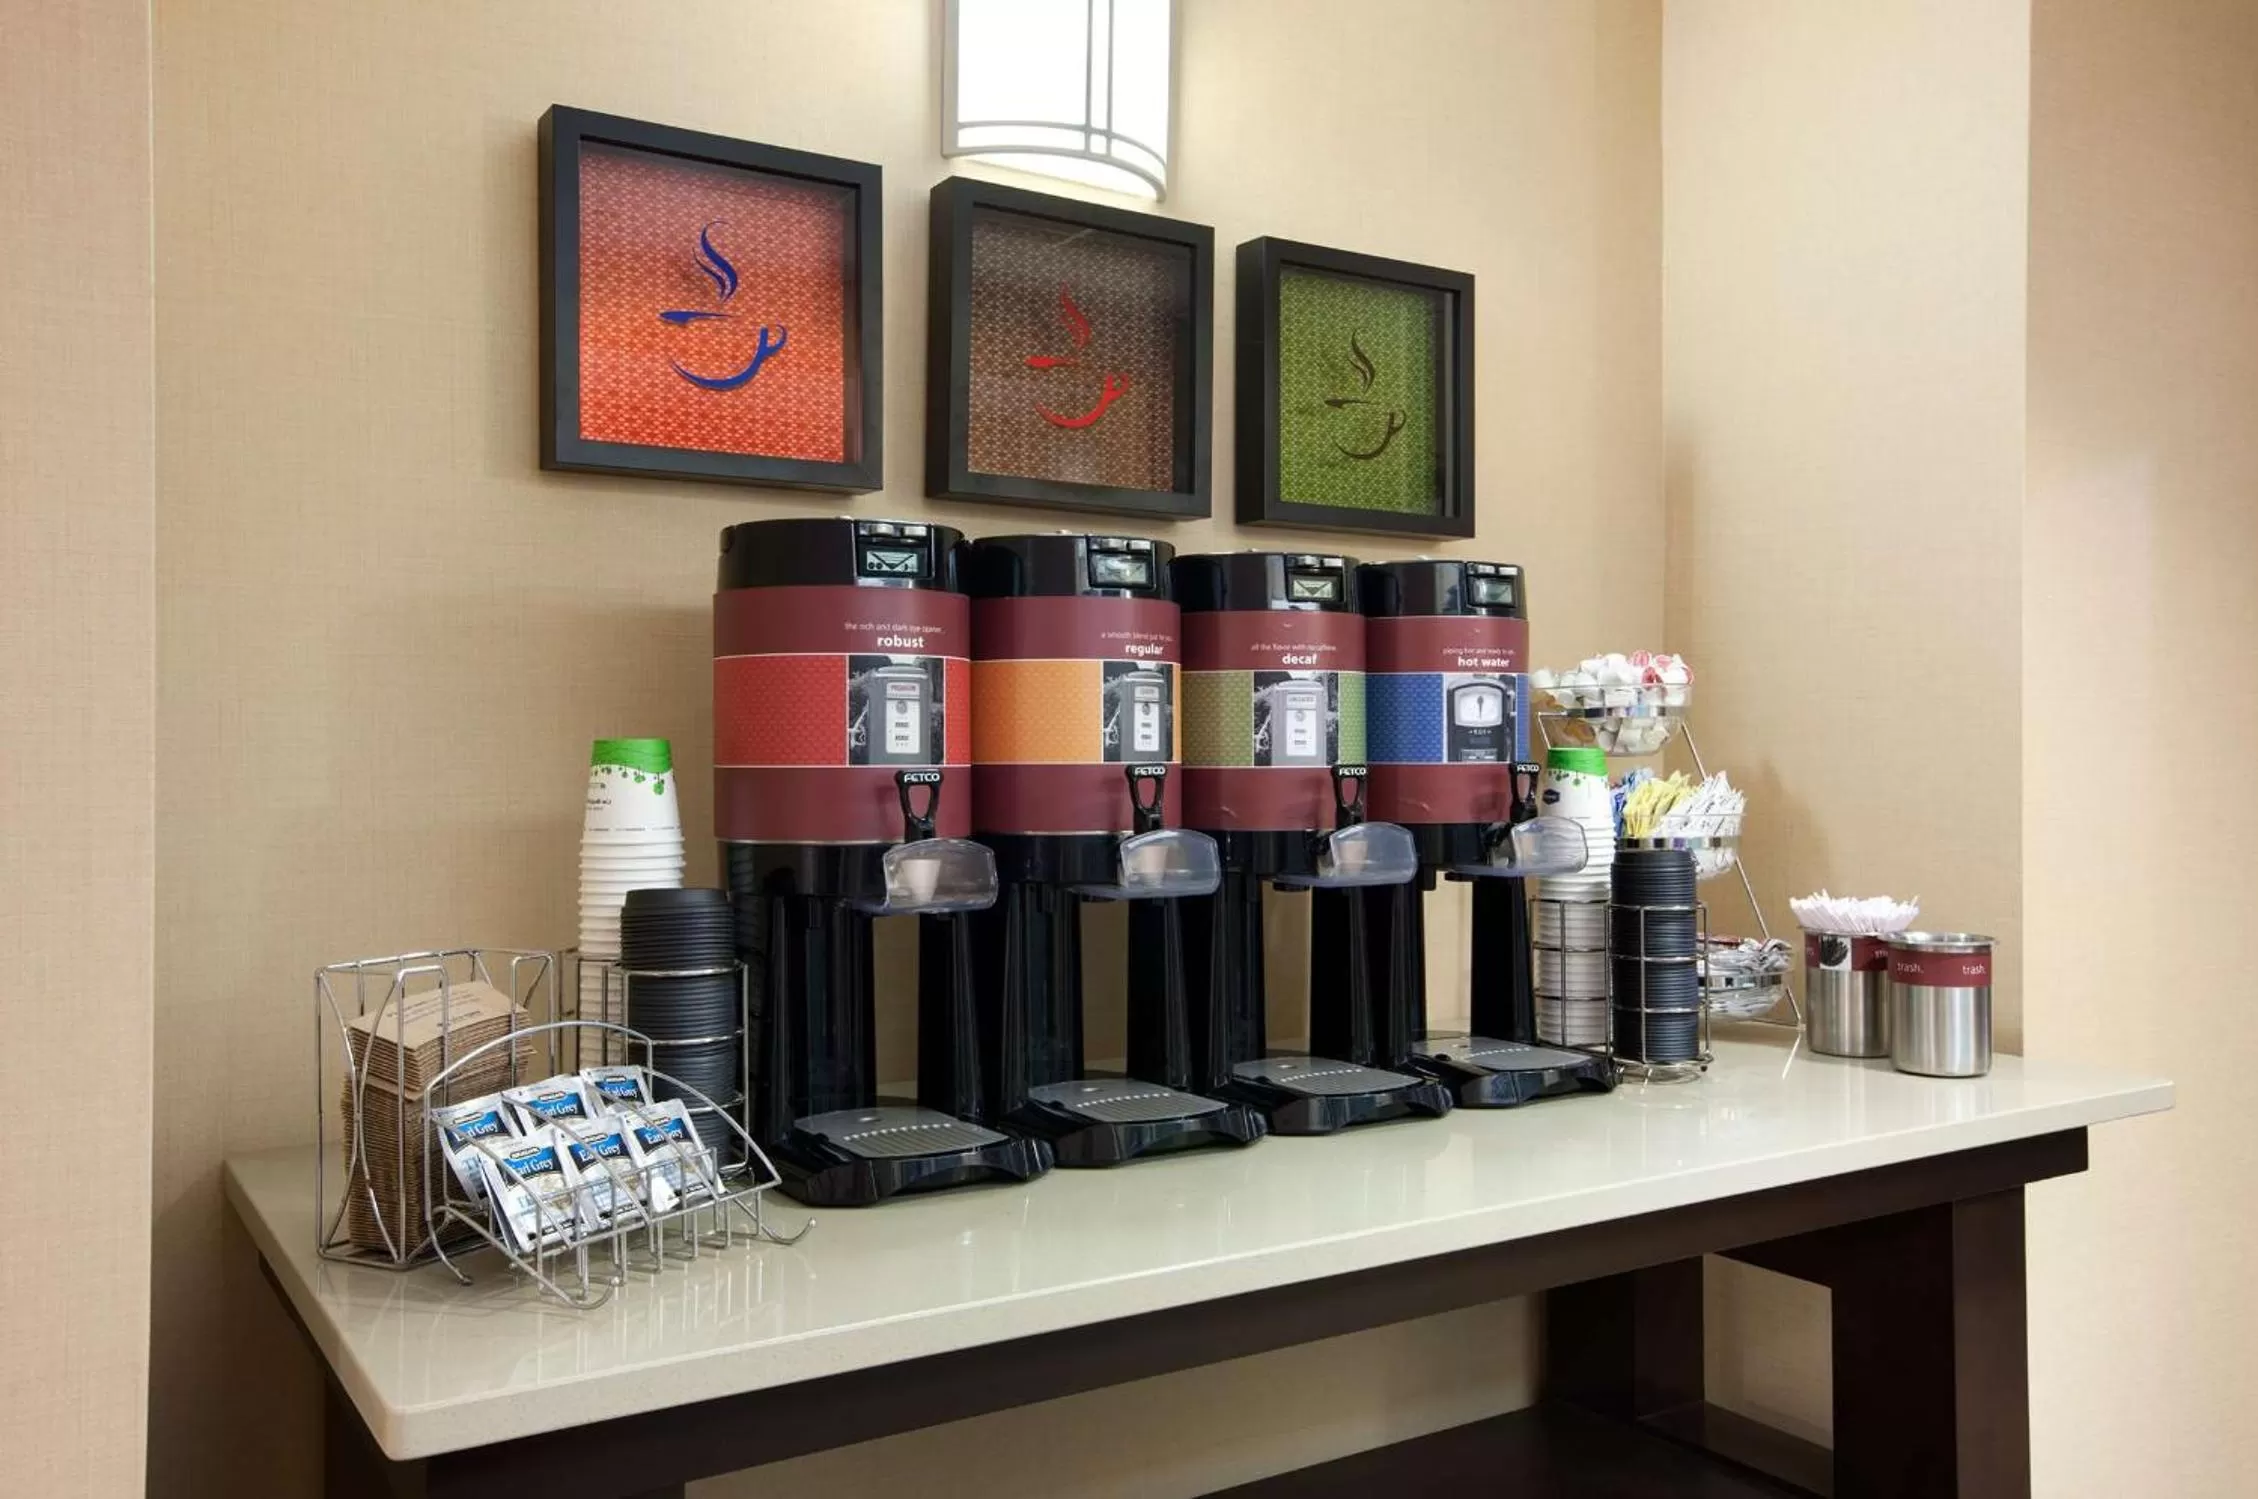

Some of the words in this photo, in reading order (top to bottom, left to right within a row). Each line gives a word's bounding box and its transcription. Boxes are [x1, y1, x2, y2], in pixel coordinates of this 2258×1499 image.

[877, 634, 924, 648] robust
[1125, 643, 1164, 657] regular
[1282, 653, 1317, 665] decaf
[1458, 656, 1478, 667] hot
[1480, 657, 1510, 668] water
[903, 772, 940, 783] FETCO
[1134, 765, 1166, 776] FETCO
[1338, 767, 1367, 776] FETCO
[556, 1101, 579, 1115] Grey
[474, 1121, 498, 1135] Grey
[598, 1143, 621, 1157] Grey
[530, 1158, 553, 1172] Grey
